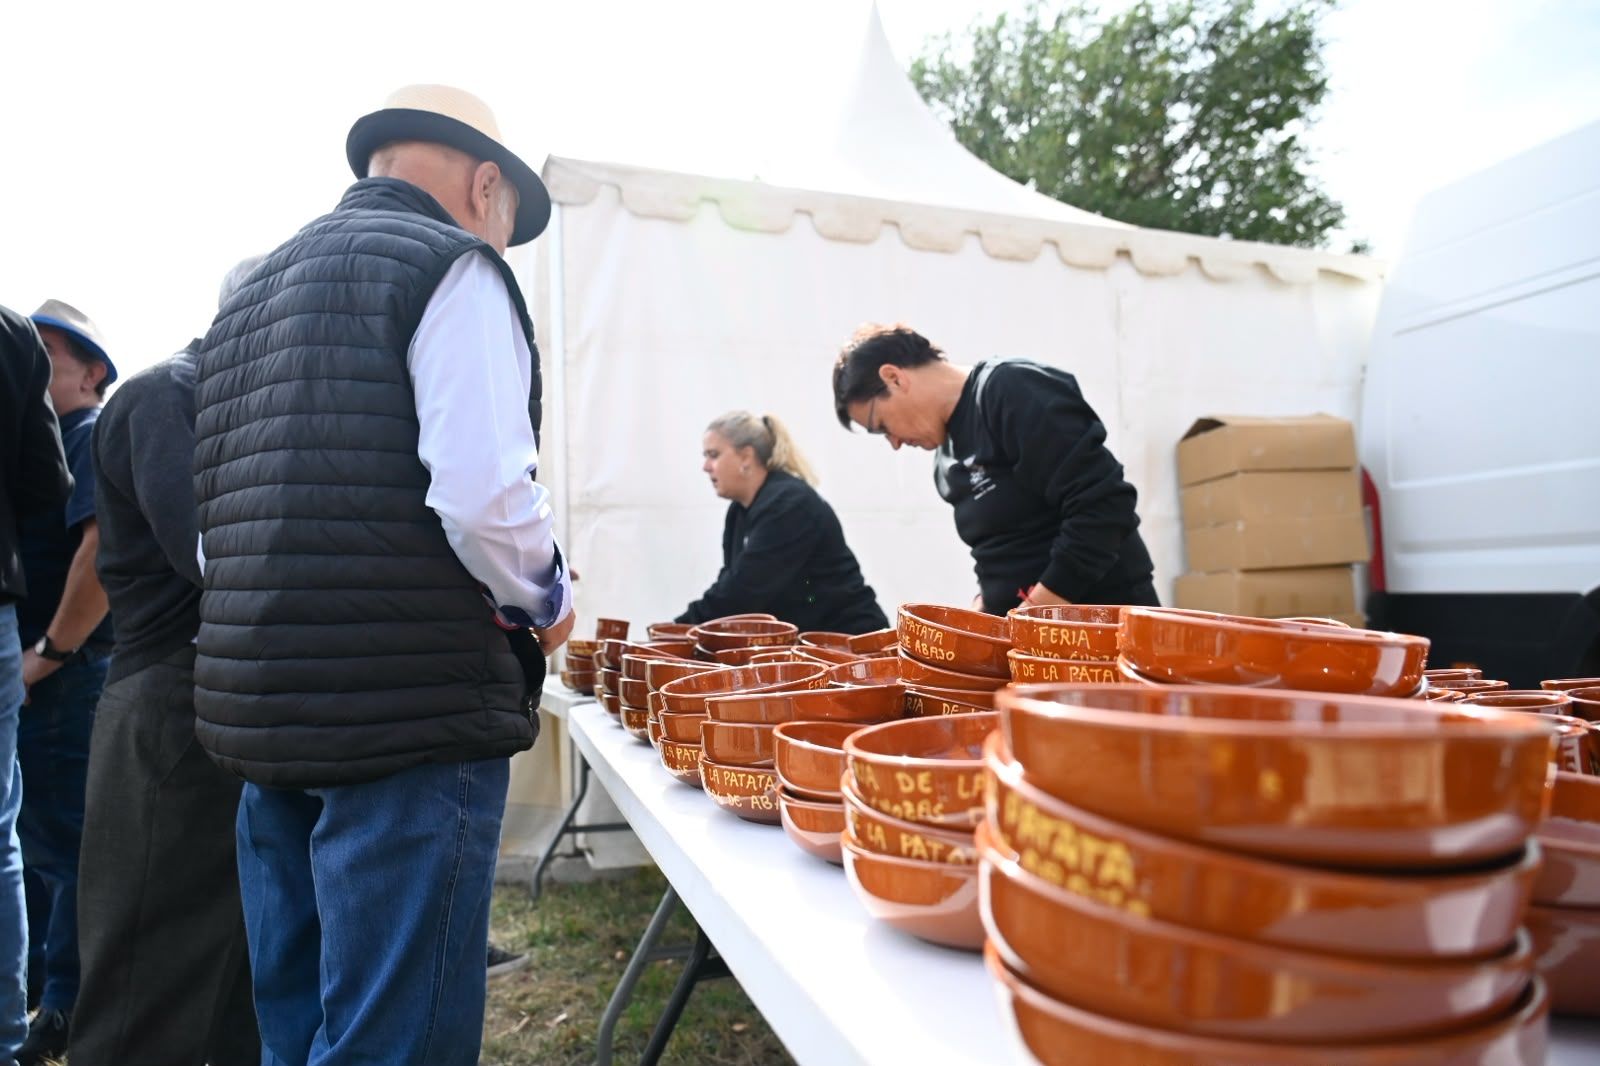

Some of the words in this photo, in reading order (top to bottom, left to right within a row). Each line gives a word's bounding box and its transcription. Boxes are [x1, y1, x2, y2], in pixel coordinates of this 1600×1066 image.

[904, 617, 943, 646] PATATA
[1038, 626, 1091, 649] FERIA
[915, 639, 955, 661] ABAJO
[1022, 662, 1035, 677] DE
[1043, 665, 1059, 681] LA
[1069, 665, 1119, 684] PATA
[676, 747, 698, 762] PAT
[708, 767, 720, 785] LA
[724, 770, 777, 791] PATATA
[896, 771, 933, 794] DE
[900, 832, 975, 866] PATA
